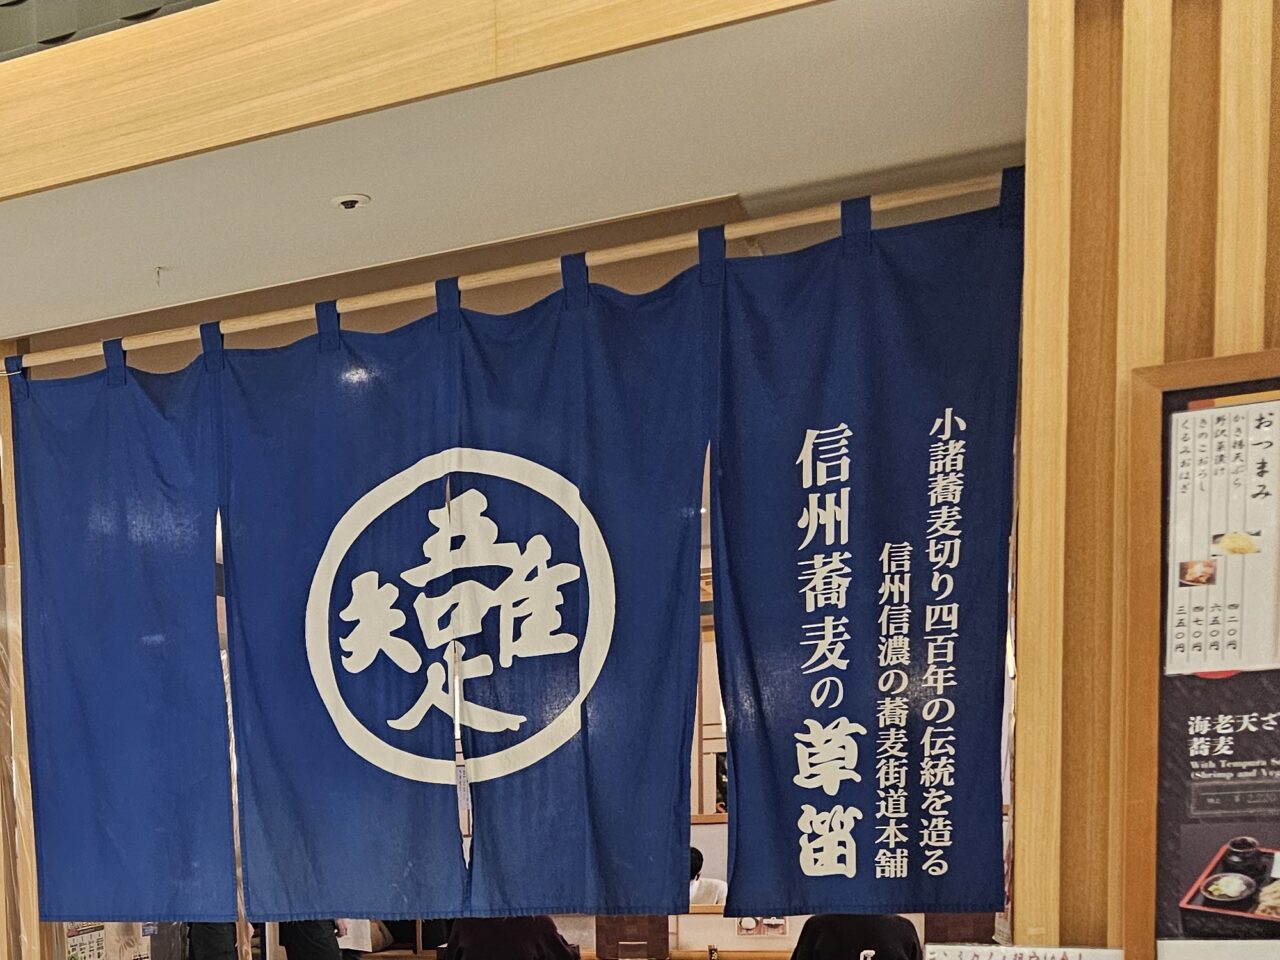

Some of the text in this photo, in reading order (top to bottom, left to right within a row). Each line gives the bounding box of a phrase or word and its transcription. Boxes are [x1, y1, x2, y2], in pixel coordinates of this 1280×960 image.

[1179, 419, 1191, 494] くるみおはぎ
[1251, 412, 1275, 499] おつまみ
[792, 422, 867, 878] 信州蕎麦の草笛
[920, 407, 967, 876] 小諸蕎麦切り四百年の伝統を造る
[874, 541, 913, 879] 信州信濃の蕎麦街道本舗
[1187, 736, 1234, 756] 蕎麦
[1190, 760, 1216, 769] With
[1236, 769, 1257, 777] and
